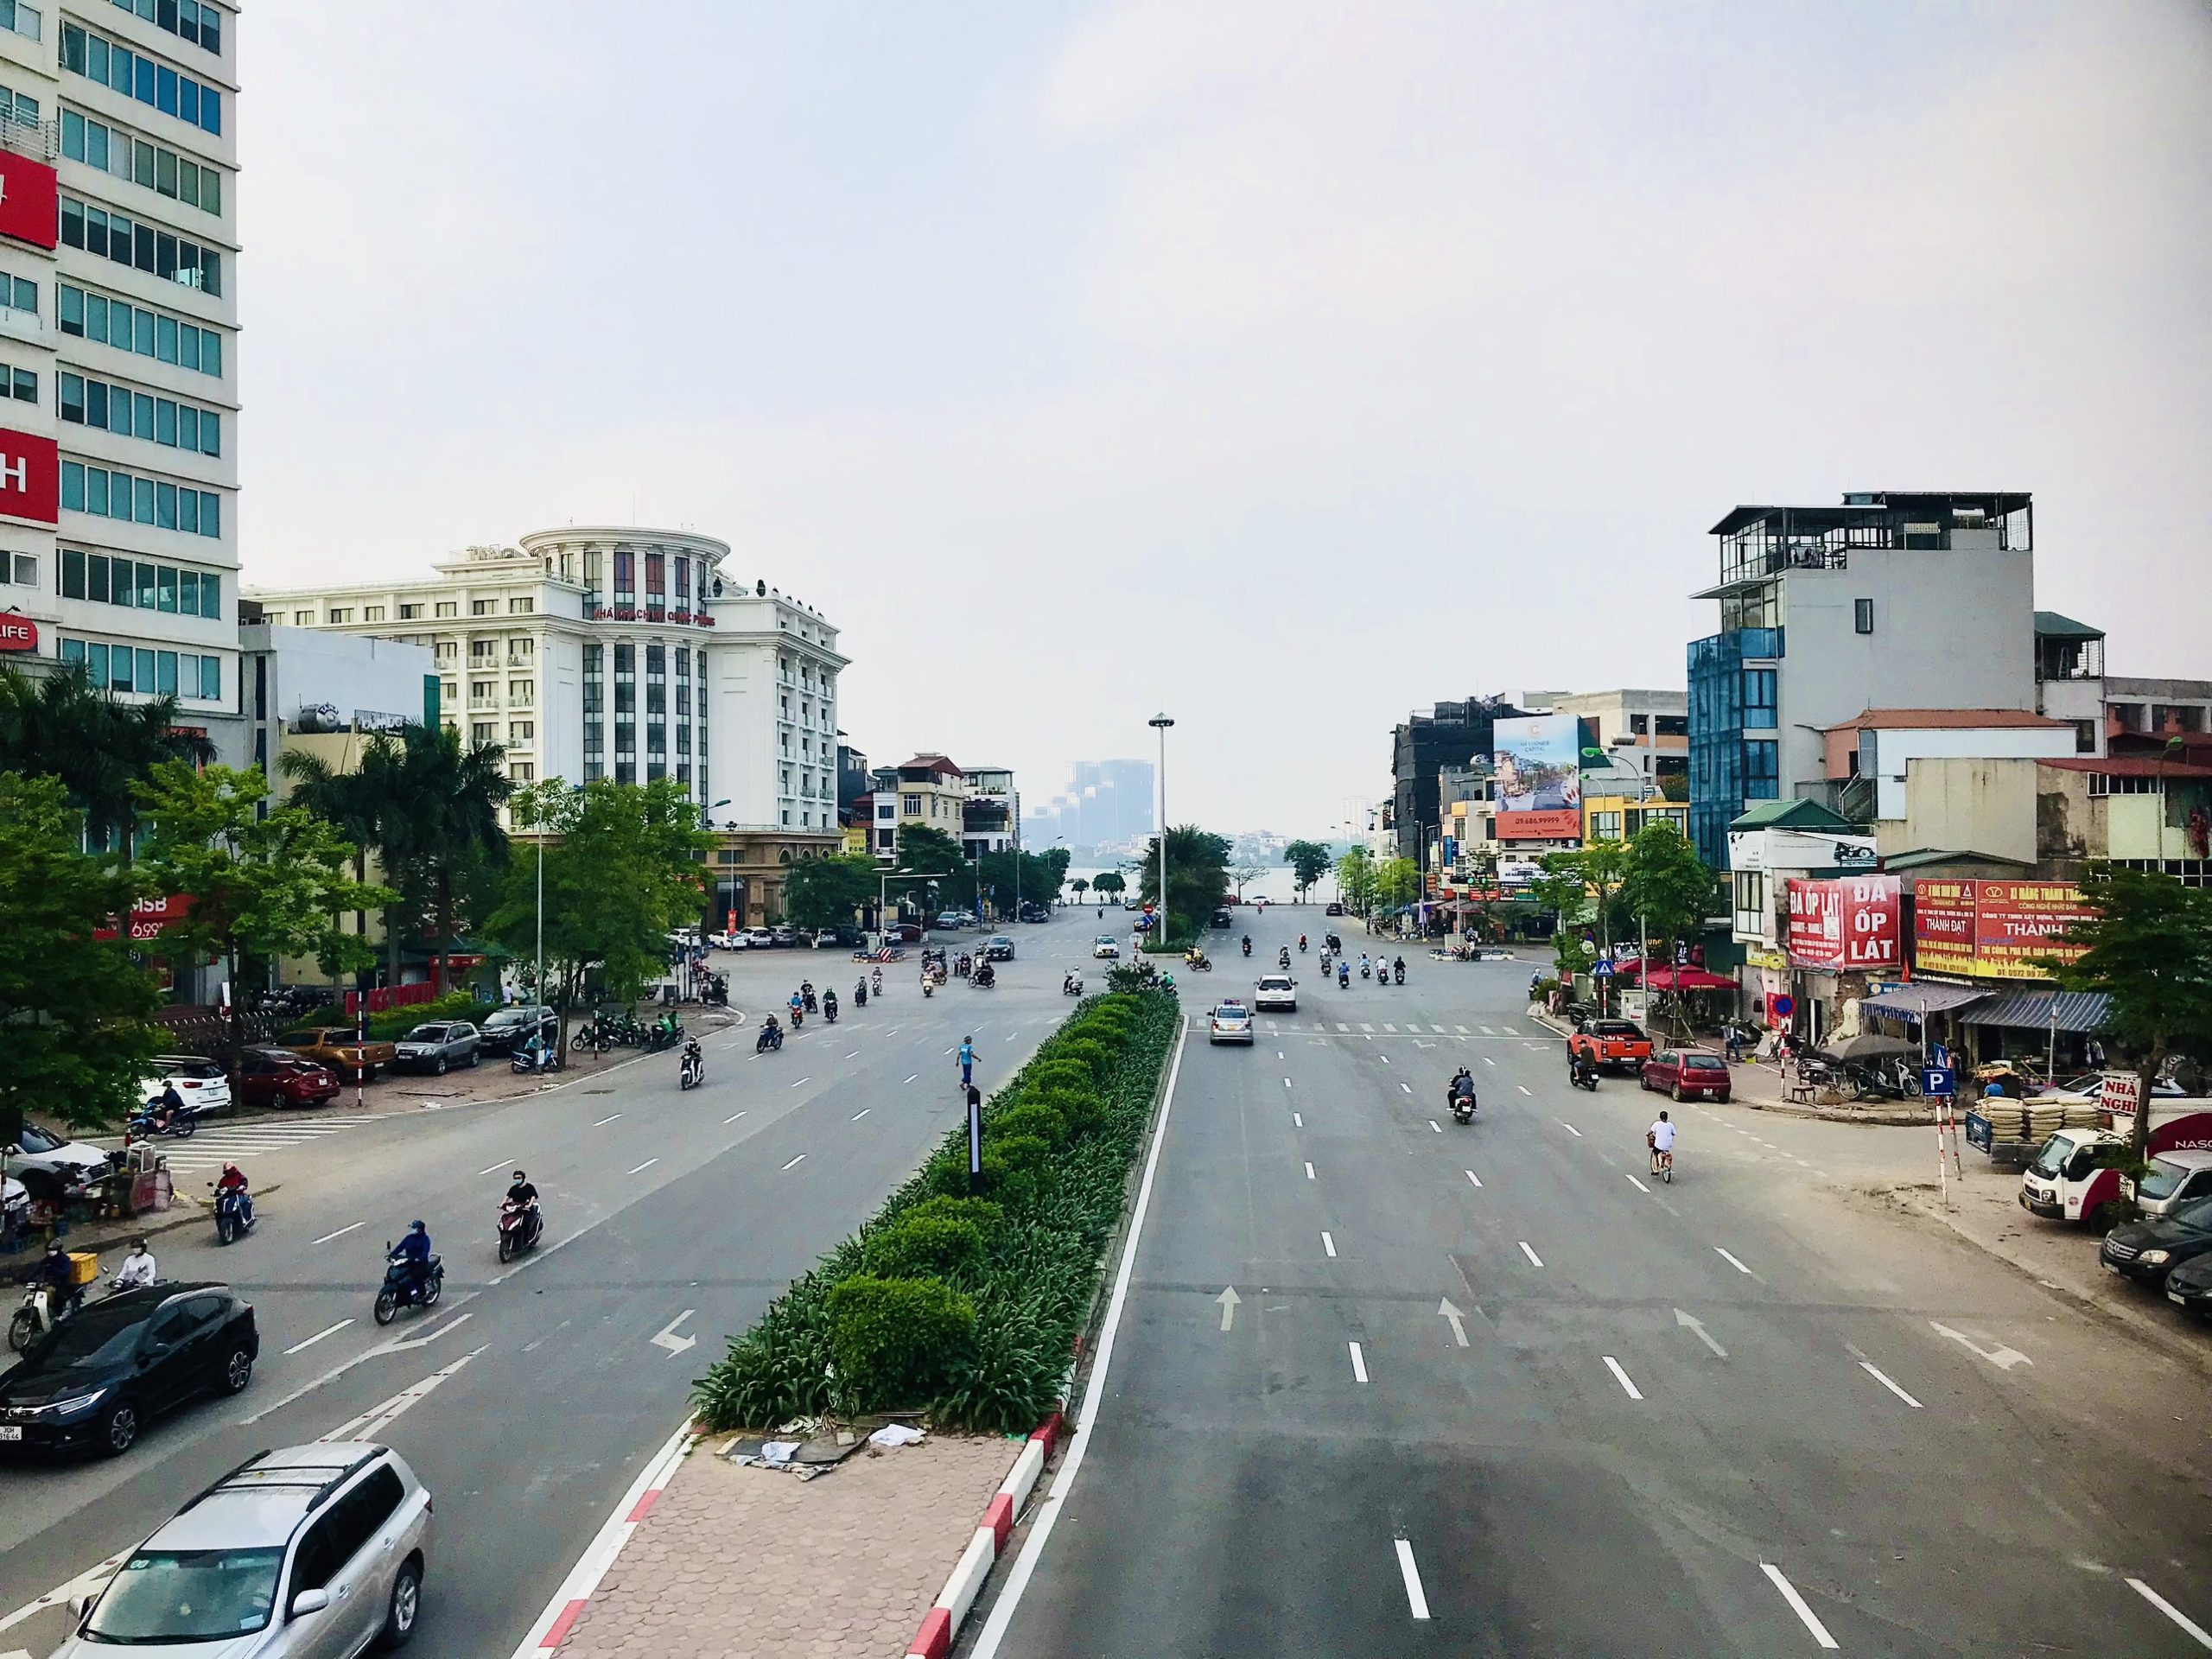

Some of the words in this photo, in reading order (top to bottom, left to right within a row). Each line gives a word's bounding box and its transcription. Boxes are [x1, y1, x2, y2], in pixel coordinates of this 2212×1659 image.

[0, 625, 29, 640] IFE
[1854, 906, 1887, 933] ỐP
[1925, 916, 1950, 932] THÀNH
[1950, 919, 1967, 936] ĐẠT
[2004, 921, 2064, 937] THÀNH
[1850, 936, 1894, 961] LÁT
[1929, 1073, 1944, 1090] P
[2105, 1080, 2137, 1096] NHÀ
